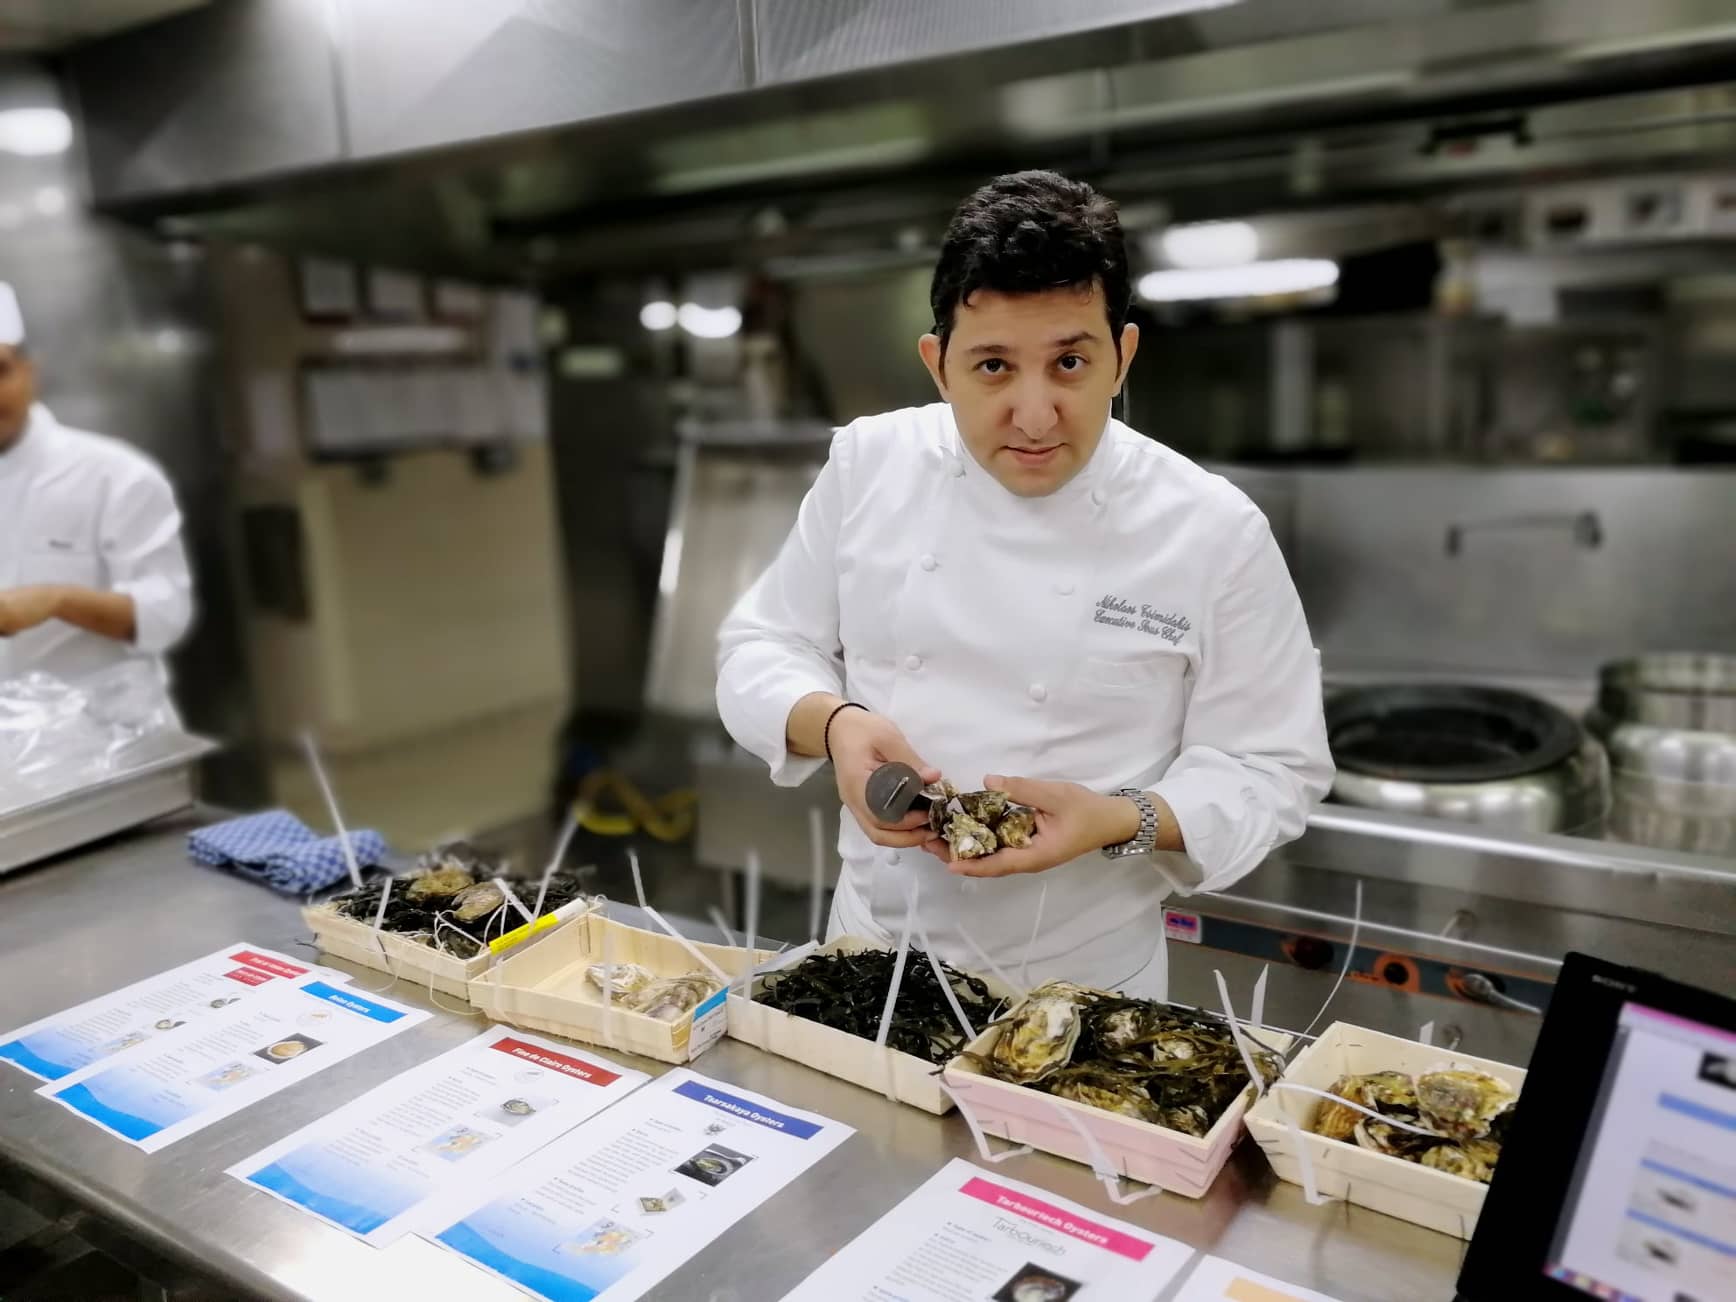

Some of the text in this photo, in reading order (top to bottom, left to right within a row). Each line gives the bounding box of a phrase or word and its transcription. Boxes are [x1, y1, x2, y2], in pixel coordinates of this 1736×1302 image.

[512, 1047, 530, 1058] Fine
[540, 1057, 562, 1068] Claire
[562, 1064, 592, 1078] Oysters
[750, 1112, 785, 1128] Oysters
[1063, 1221, 1109, 1245] Oysters
